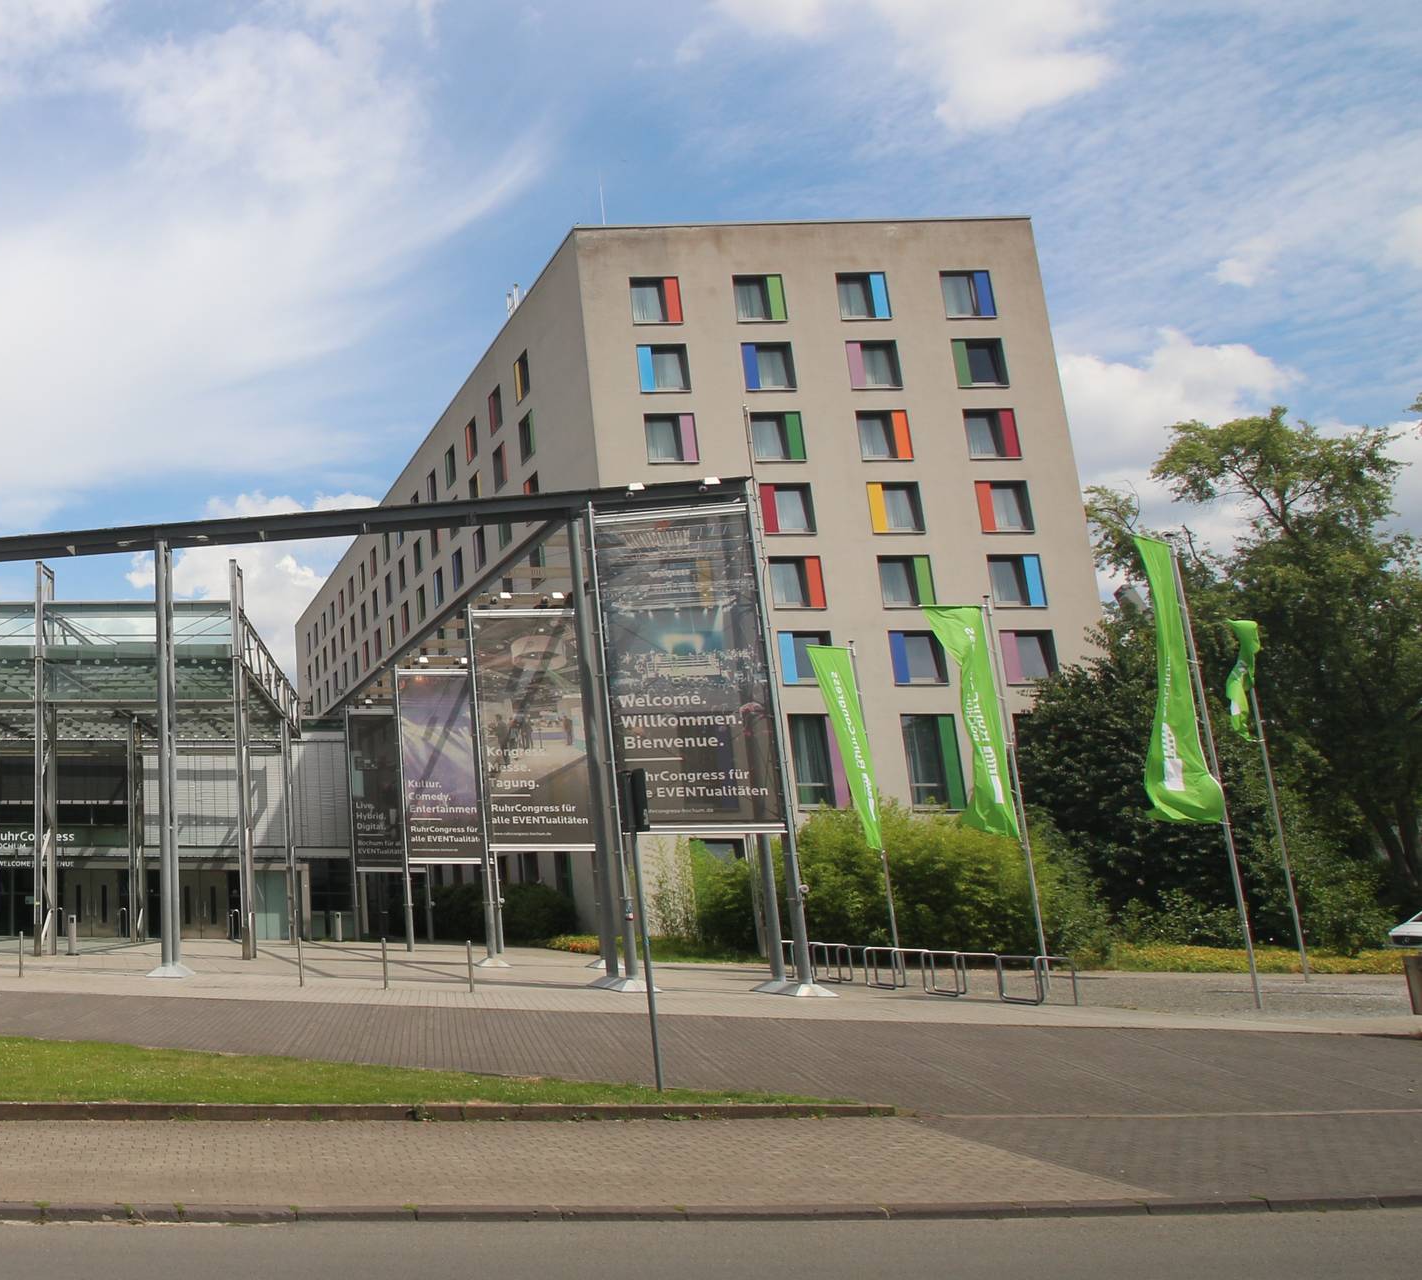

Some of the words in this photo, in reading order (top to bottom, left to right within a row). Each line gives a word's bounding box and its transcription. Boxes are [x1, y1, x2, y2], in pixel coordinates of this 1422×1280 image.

[618, 694, 707, 708] Welcome.
[621, 714, 743, 728] Willkommen.
[623, 736, 725, 750] Bienvenue.
[644, 771, 725, 783] hrCongress
[728, 769, 750, 780] für
[408, 779, 442, 789] Kultur.
[488, 777, 540, 790] Tagung.
[408, 791, 451, 804] Comedy.
[656, 785, 769, 798] EVENTualitäten
[409, 803, 477, 814] Entertainmen
[491, 803, 560, 814] RuhrCongress
[561, 803, 577, 813] für
[491, 815, 511, 825] alle
[512, 815, 589, 825] EVENTualitäten
[410, 825, 466, 834] RuhrCongress
[466, 825, 478, 833] für
